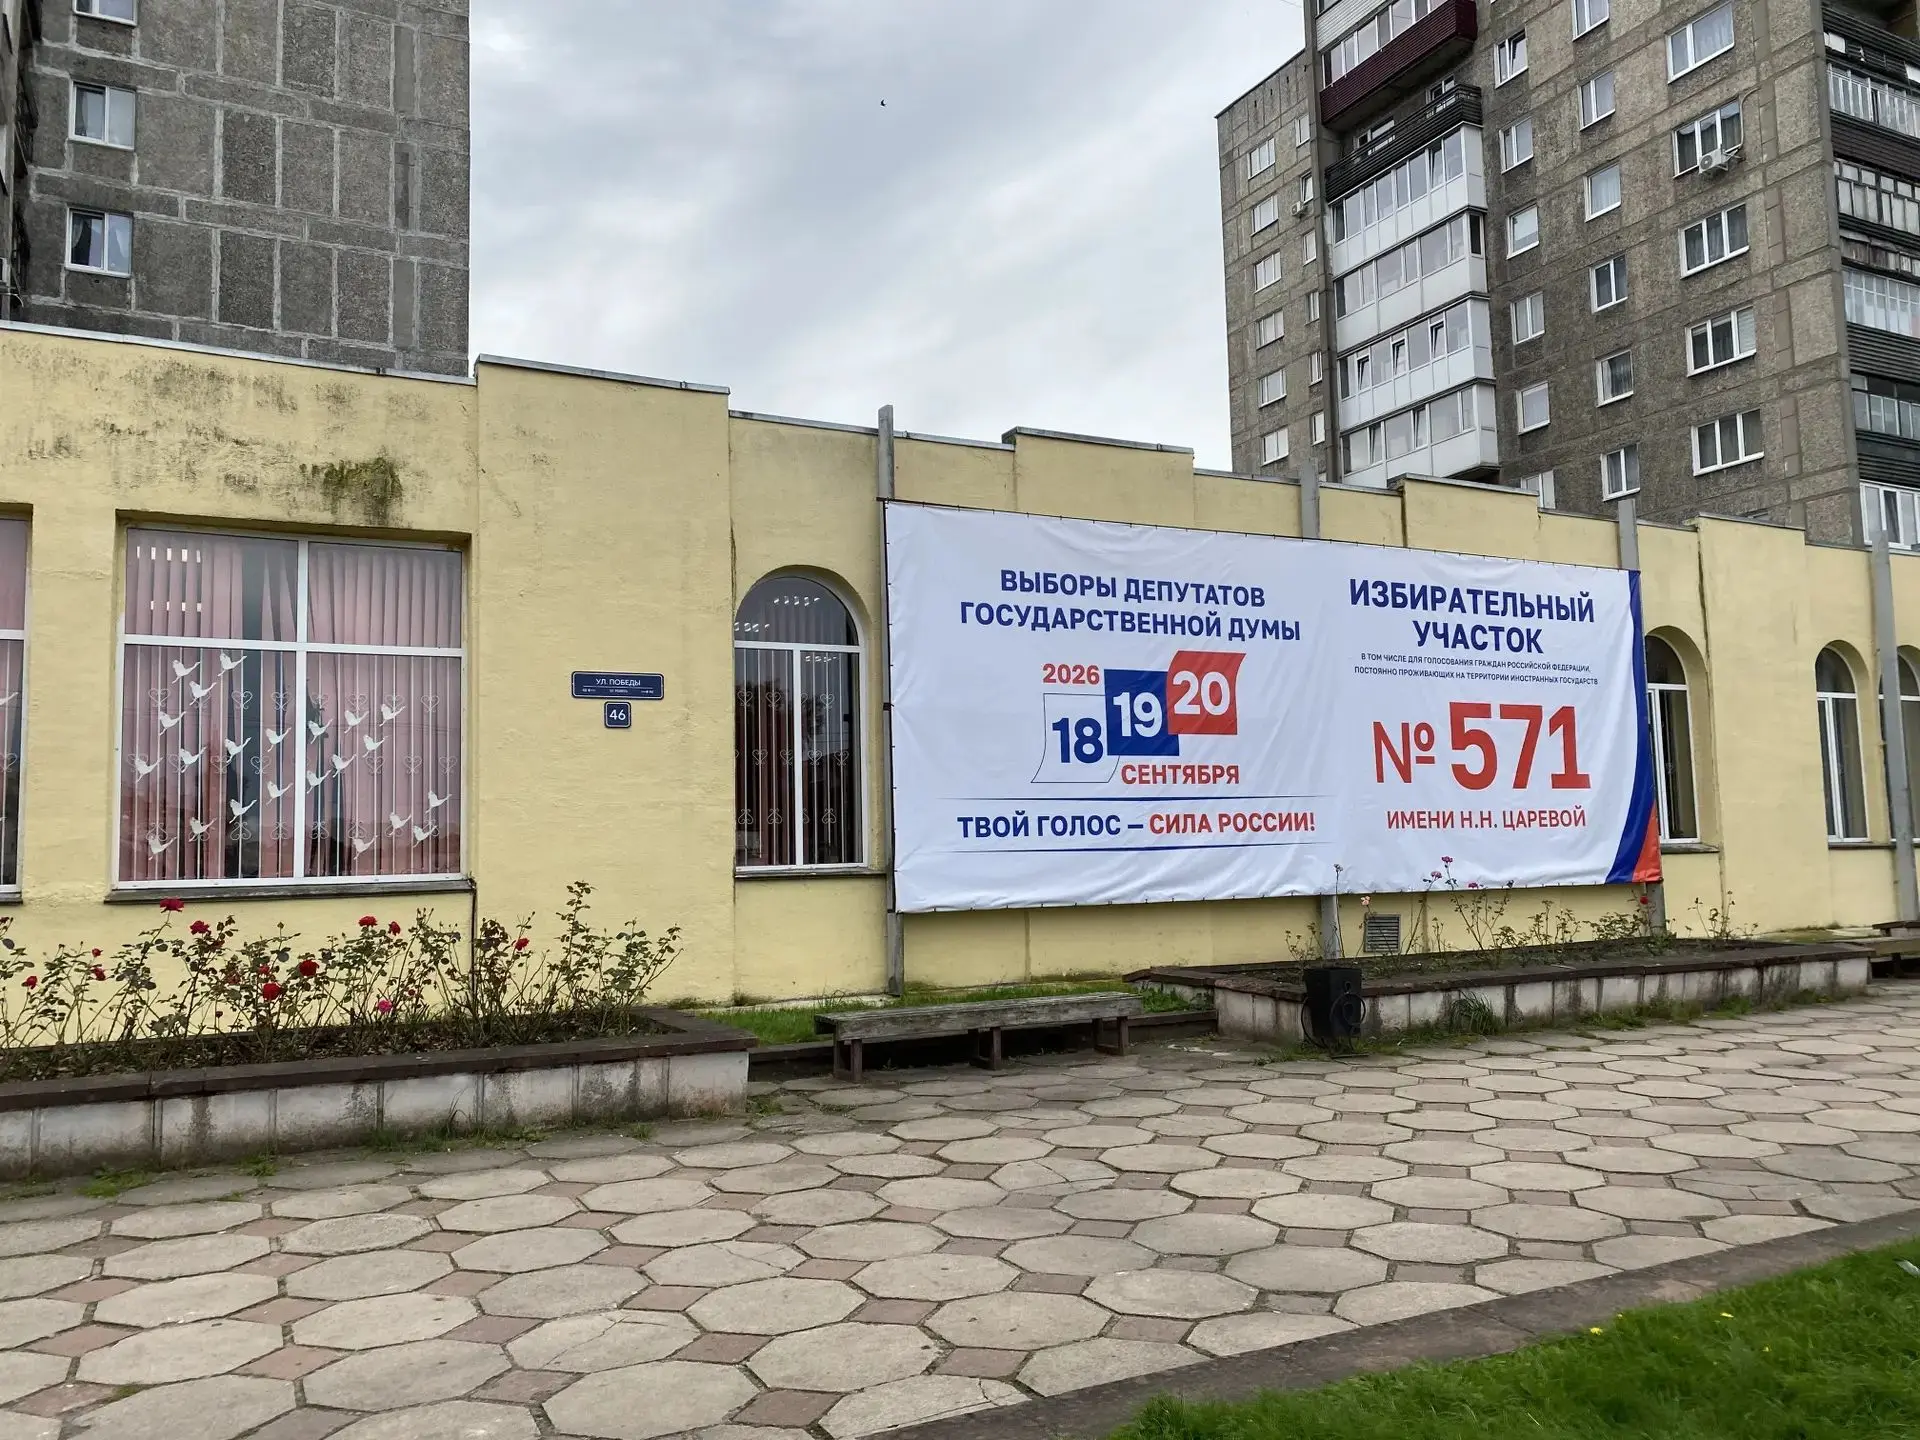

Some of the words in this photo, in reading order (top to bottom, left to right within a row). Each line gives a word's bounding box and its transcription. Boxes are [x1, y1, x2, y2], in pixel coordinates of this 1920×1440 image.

[1000, 569, 1117, 598] ВЫБОРЫ
[1124, 577, 1266, 608] ДЕПУТАТОВ
[1349, 578, 1595, 623] ИЗБИРАТЕЛЬНЫЙ
[960, 601, 1221, 637] ГОСУДАРСТВЕННОЙ
[1228, 617, 1301, 641] ДУМЫ
[1412, 620, 1544, 654] УЧАСТОК
[1042, 663, 1100, 686] 2026
[1354, 666, 1397, 676] ПОСТОЯННО
[1398, 668, 1454, 679] ПРОЖИВАЮЩИХ
[1467, 672, 1509, 681] ТЕРРИТОРИИ
[1510, 674, 1559, 683] ИНОСТРАННЫХ
[1560, 676, 1599, 685] ГОСУДАРСТВ
[1361, 652, 1366, 660] В
[1367, 653, 1382, 661] ТОМ
[1383, 654, 1407, 663] ЧИСЛЕ
[1408, 656, 1423, 664] ДЛЯ
[1424, 656, 1473, 666] ГОЛОСОВАНИЯ
[1474, 660, 1506, 668] ГРАЖДАН
[1507, 661, 1552, 670] РОССИЙСКОЙ
[1552, 664, 1591, 673] ФЕДЕРАЦИИ,
[609, 679, 641, 687] ПОБЕДЫ
[609, 709, 626, 720] 46
[1051, 717, 1104, 764] 18
[1112, 691, 1162, 738] 19
[1172, 670, 1231, 716] 20
[1372, 721, 1436, 784] №
[1449, 701, 1591, 790] 571
[1121, 764, 1240, 785] СЕНТЯБРЯ
[957, 810, 1029, 838] ТВОЙ
[1037, 814, 1121, 837] ГОЛОС
[1149, 813, 1212, 834] СИЛА
[1218, 811, 1315, 833] РОССИИ!
[1387, 810, 1454, 829] ИМЕНИ
[1460, 809, 1498, 829] Н.Н.
[1503, 805, 1586, 831] ЦАРЕВОЙ
